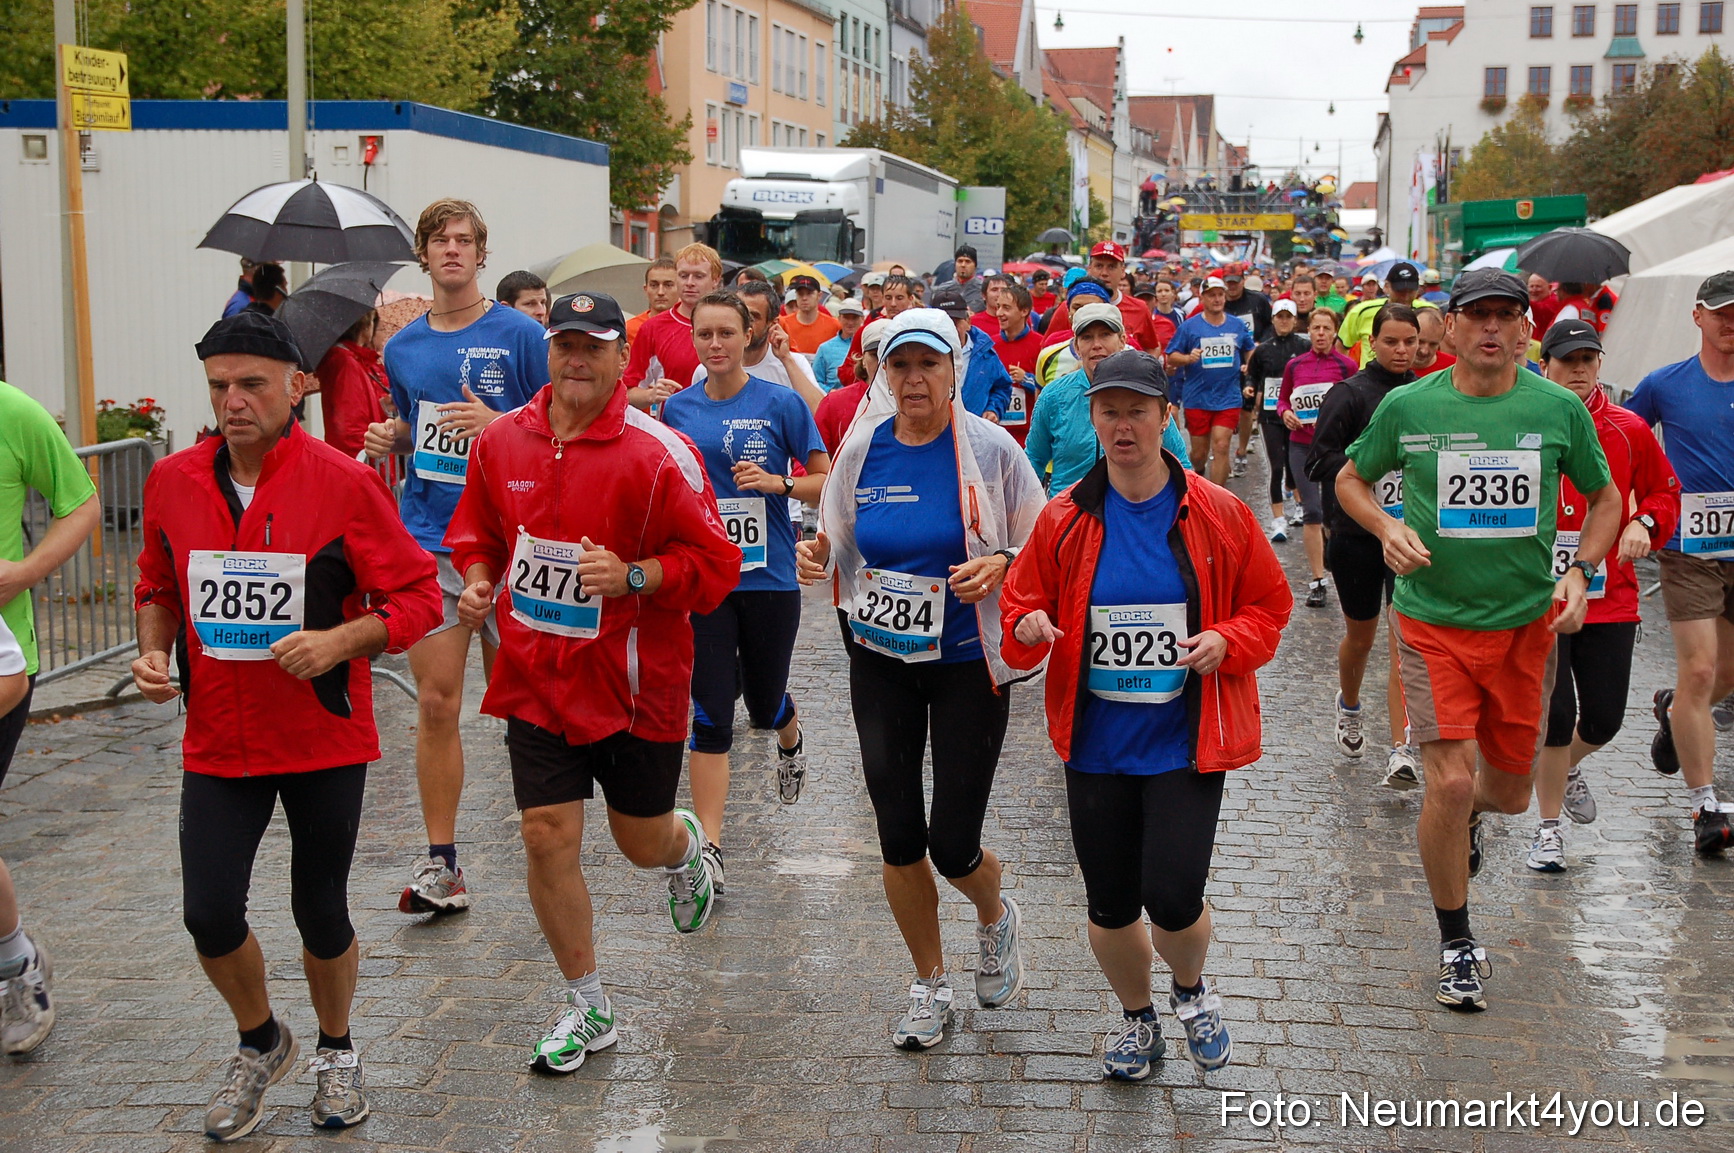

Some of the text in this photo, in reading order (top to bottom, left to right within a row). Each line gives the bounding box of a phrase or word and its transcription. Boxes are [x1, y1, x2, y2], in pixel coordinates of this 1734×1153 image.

[74, 50, 109, 68] Kinder-
[753, 190, 815, 203] BOCK
[965, 216, 1005, 235] BO
[1216, 217, 1255, 228] START
[1205, 345, 1232, 357] 2643
[437, 459, 464, 473] Peter
[1469, 456, 1509, 466] BOCK
[1448, 474, 1530, 506] 2336
[1469, 513, 1507, 526] Alfred
[1690, 511, 1734, 535] 307
[533, 544, 574, 559] BOCK
[223, 558, 267, 570] BOCK
[880, 576, 913, 589] BOCK
[200, 579, 293, 621] 2852
[534, 603, 562, 621] Uwe
[858, 591, 934, 633] 3284
[1109, 611, 1153, 622] BOCK
[213, 628, 271, 645] Herbert
[1091, 630, 1179, 667] 2923
[1117, 676, 1152, 691] petra
